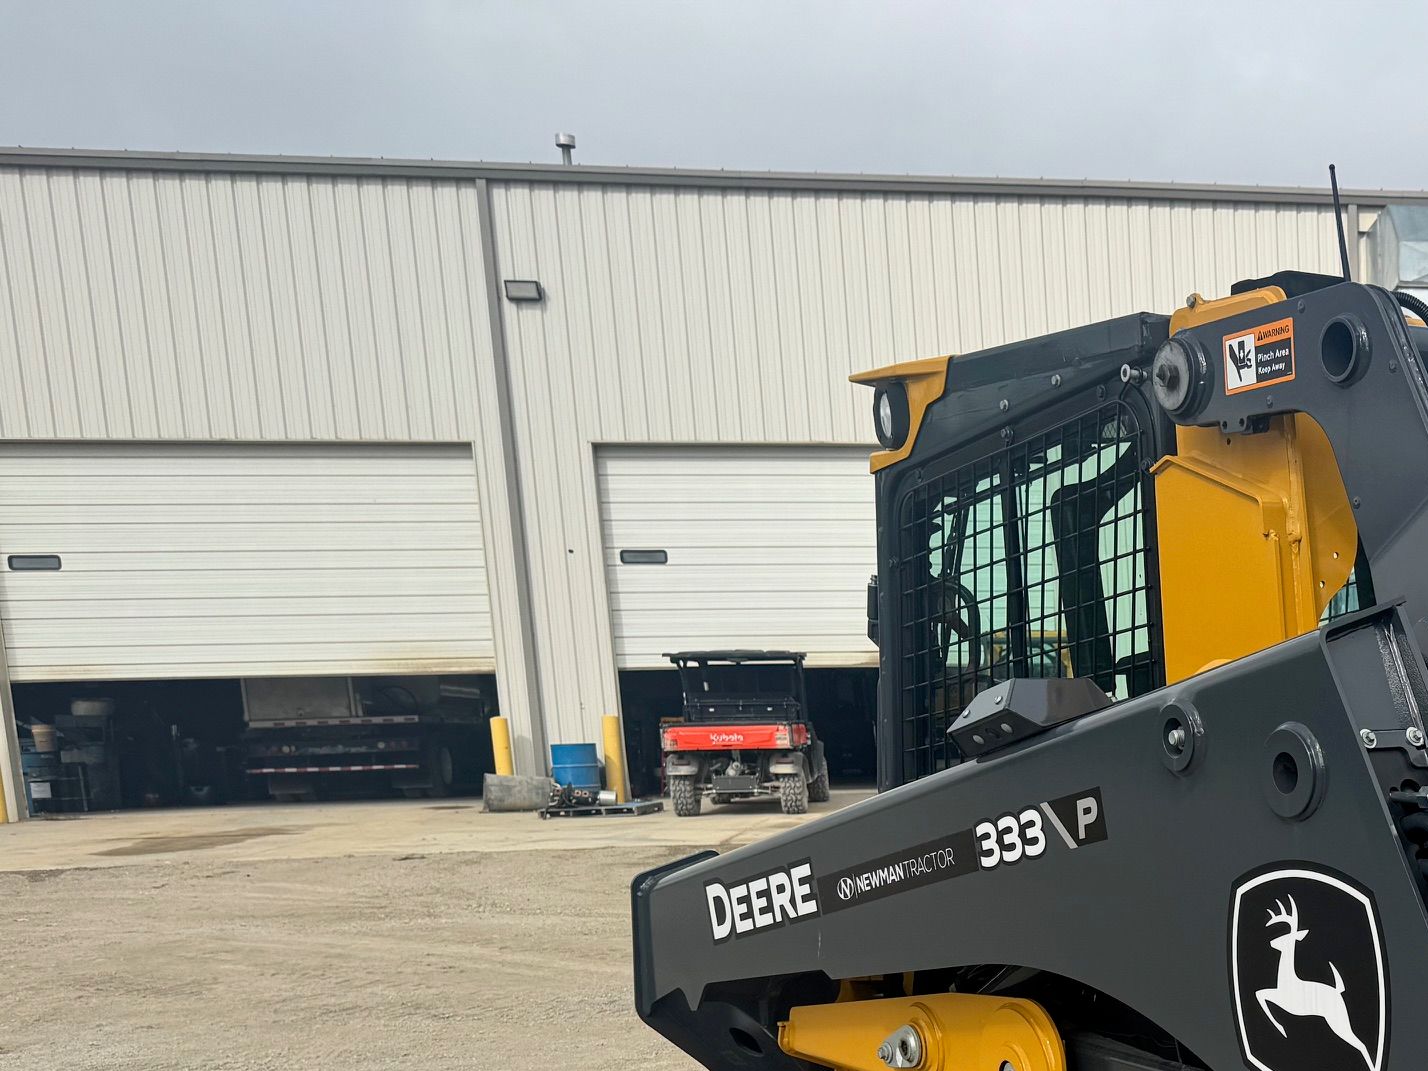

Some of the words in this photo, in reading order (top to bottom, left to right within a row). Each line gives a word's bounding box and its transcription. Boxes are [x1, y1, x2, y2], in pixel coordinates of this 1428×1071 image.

[1262, 325, 1289, 338] WARNING
[1257, 351, 1275, 363] Pinch
[1275, 348, 1290, 358] Area
[1257, 366, 1271, 375] Keep
[1271, 362, 1286, 372] Away
[709, 732, 744, 745] Kubota
[975, 809, 1046, 868] 333
[1076, 796, 1098, 840] P
[705, 863, 818, 940] DEERE
